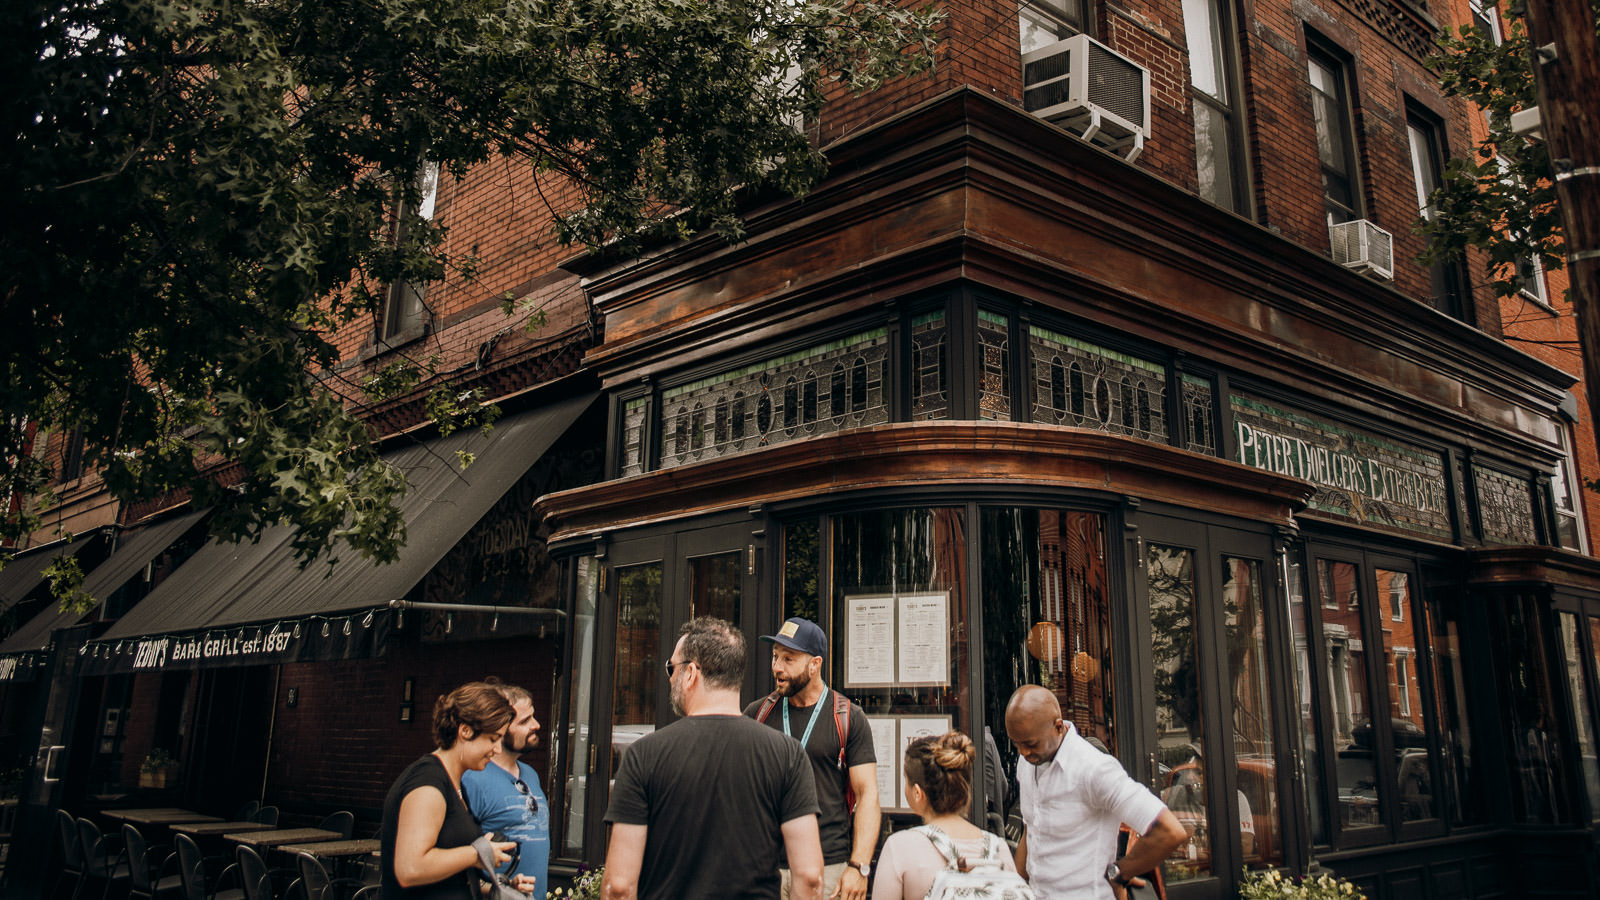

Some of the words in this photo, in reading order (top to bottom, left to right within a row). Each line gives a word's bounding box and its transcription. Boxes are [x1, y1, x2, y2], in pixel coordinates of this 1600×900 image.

[1237, 421, 1295, 478] PETER
[1296, 438, 1367, 494] DOELGER'S
[1367, 458, 1414, 507] EXTRA
[132, 637, 169, 668] TEDDY'S
[204, 637, 239, 657] GRILL
[261, 631, 292, 653] 1887
